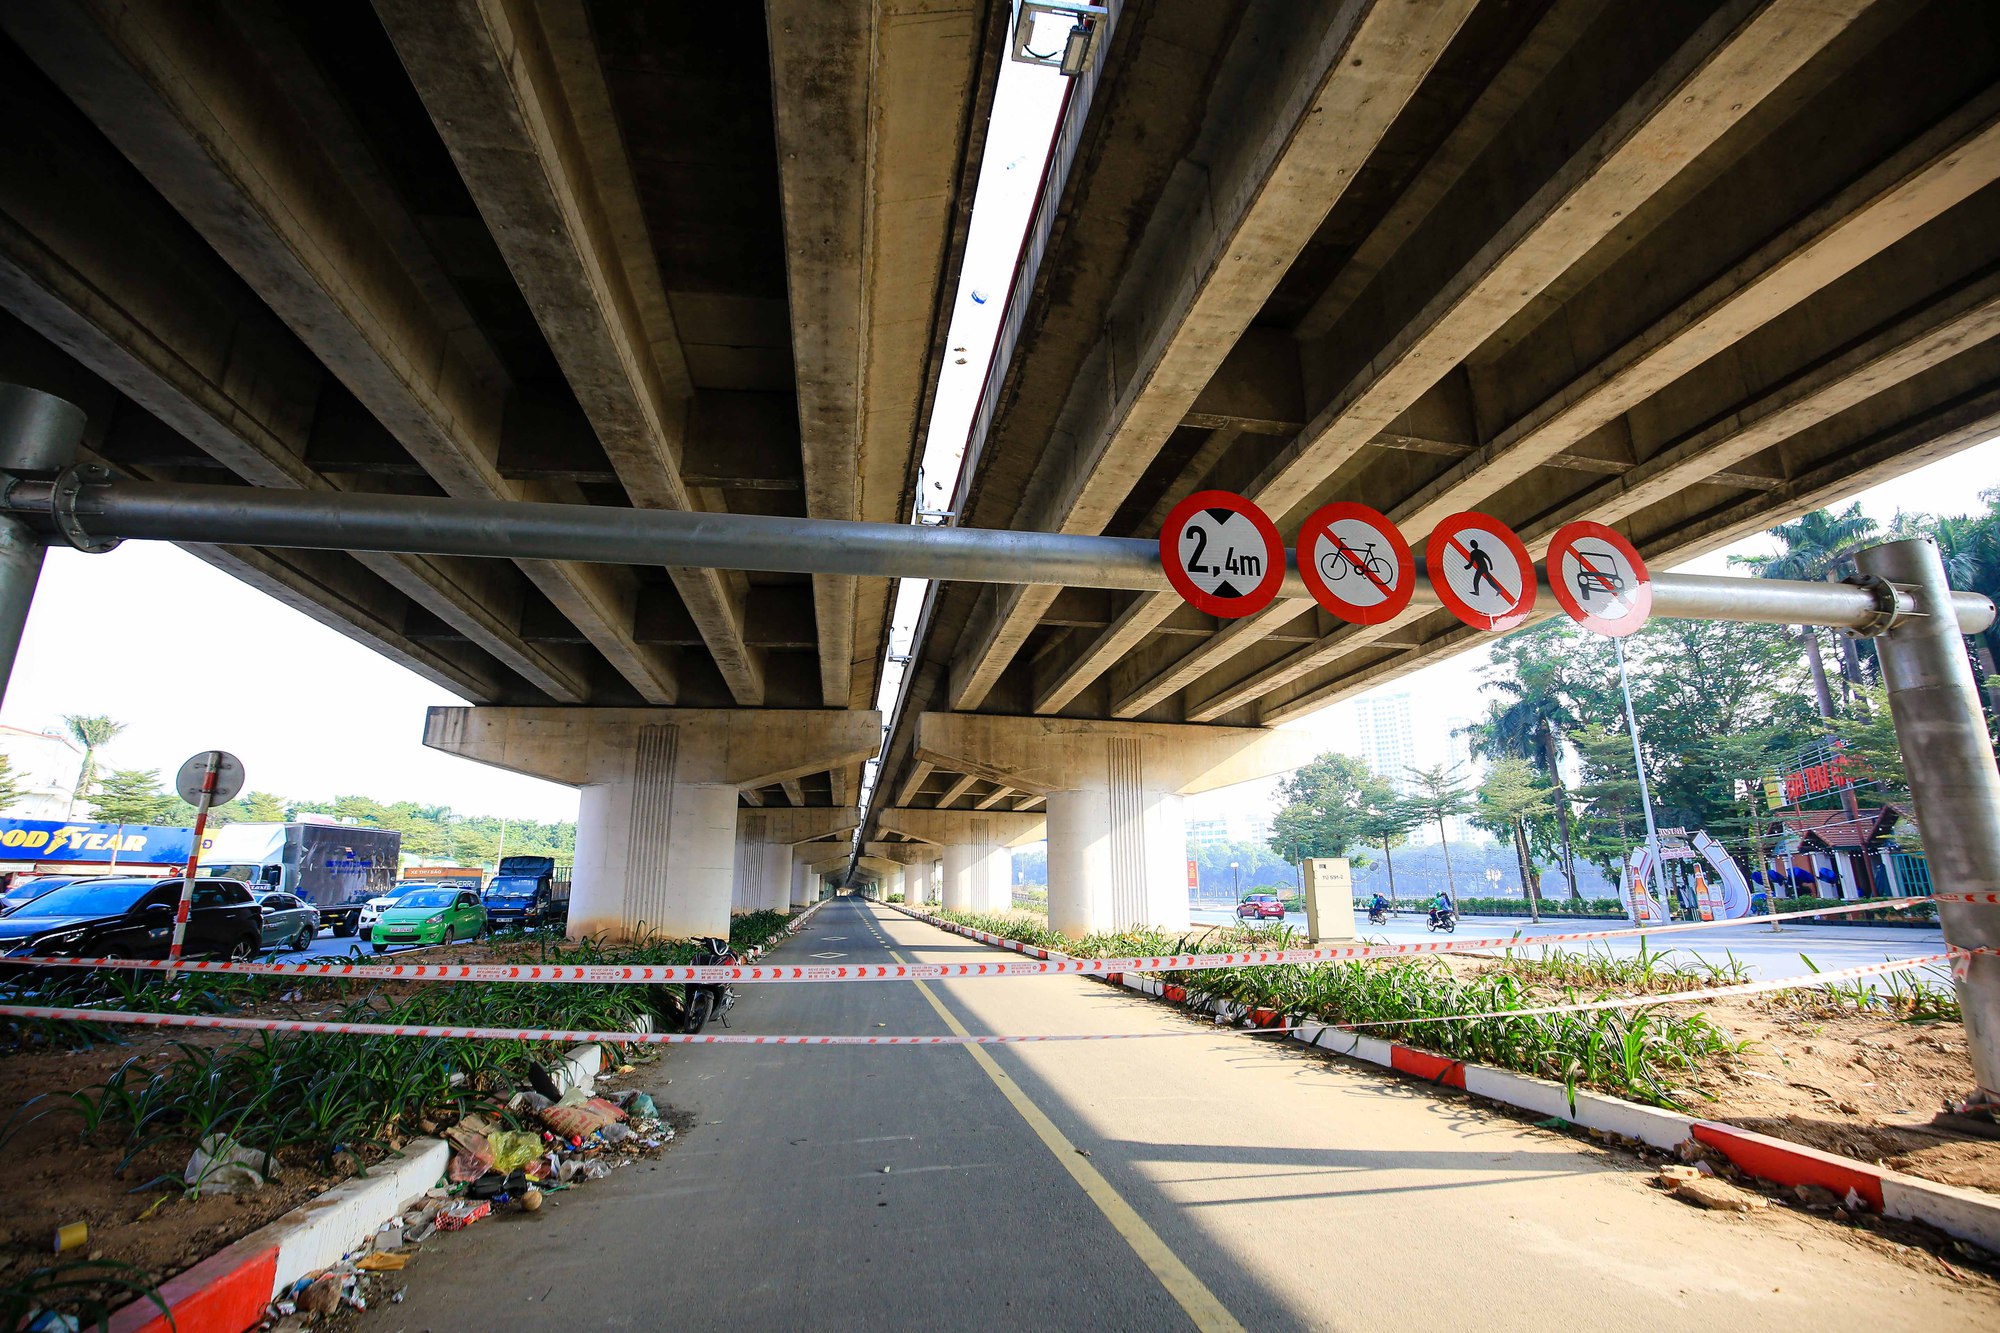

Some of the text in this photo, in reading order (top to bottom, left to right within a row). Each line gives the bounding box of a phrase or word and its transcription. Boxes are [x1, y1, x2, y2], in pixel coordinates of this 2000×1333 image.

[1186, 525, 1261, 578] 2,4m
[0, 829, 148, 852] OD YEAR
